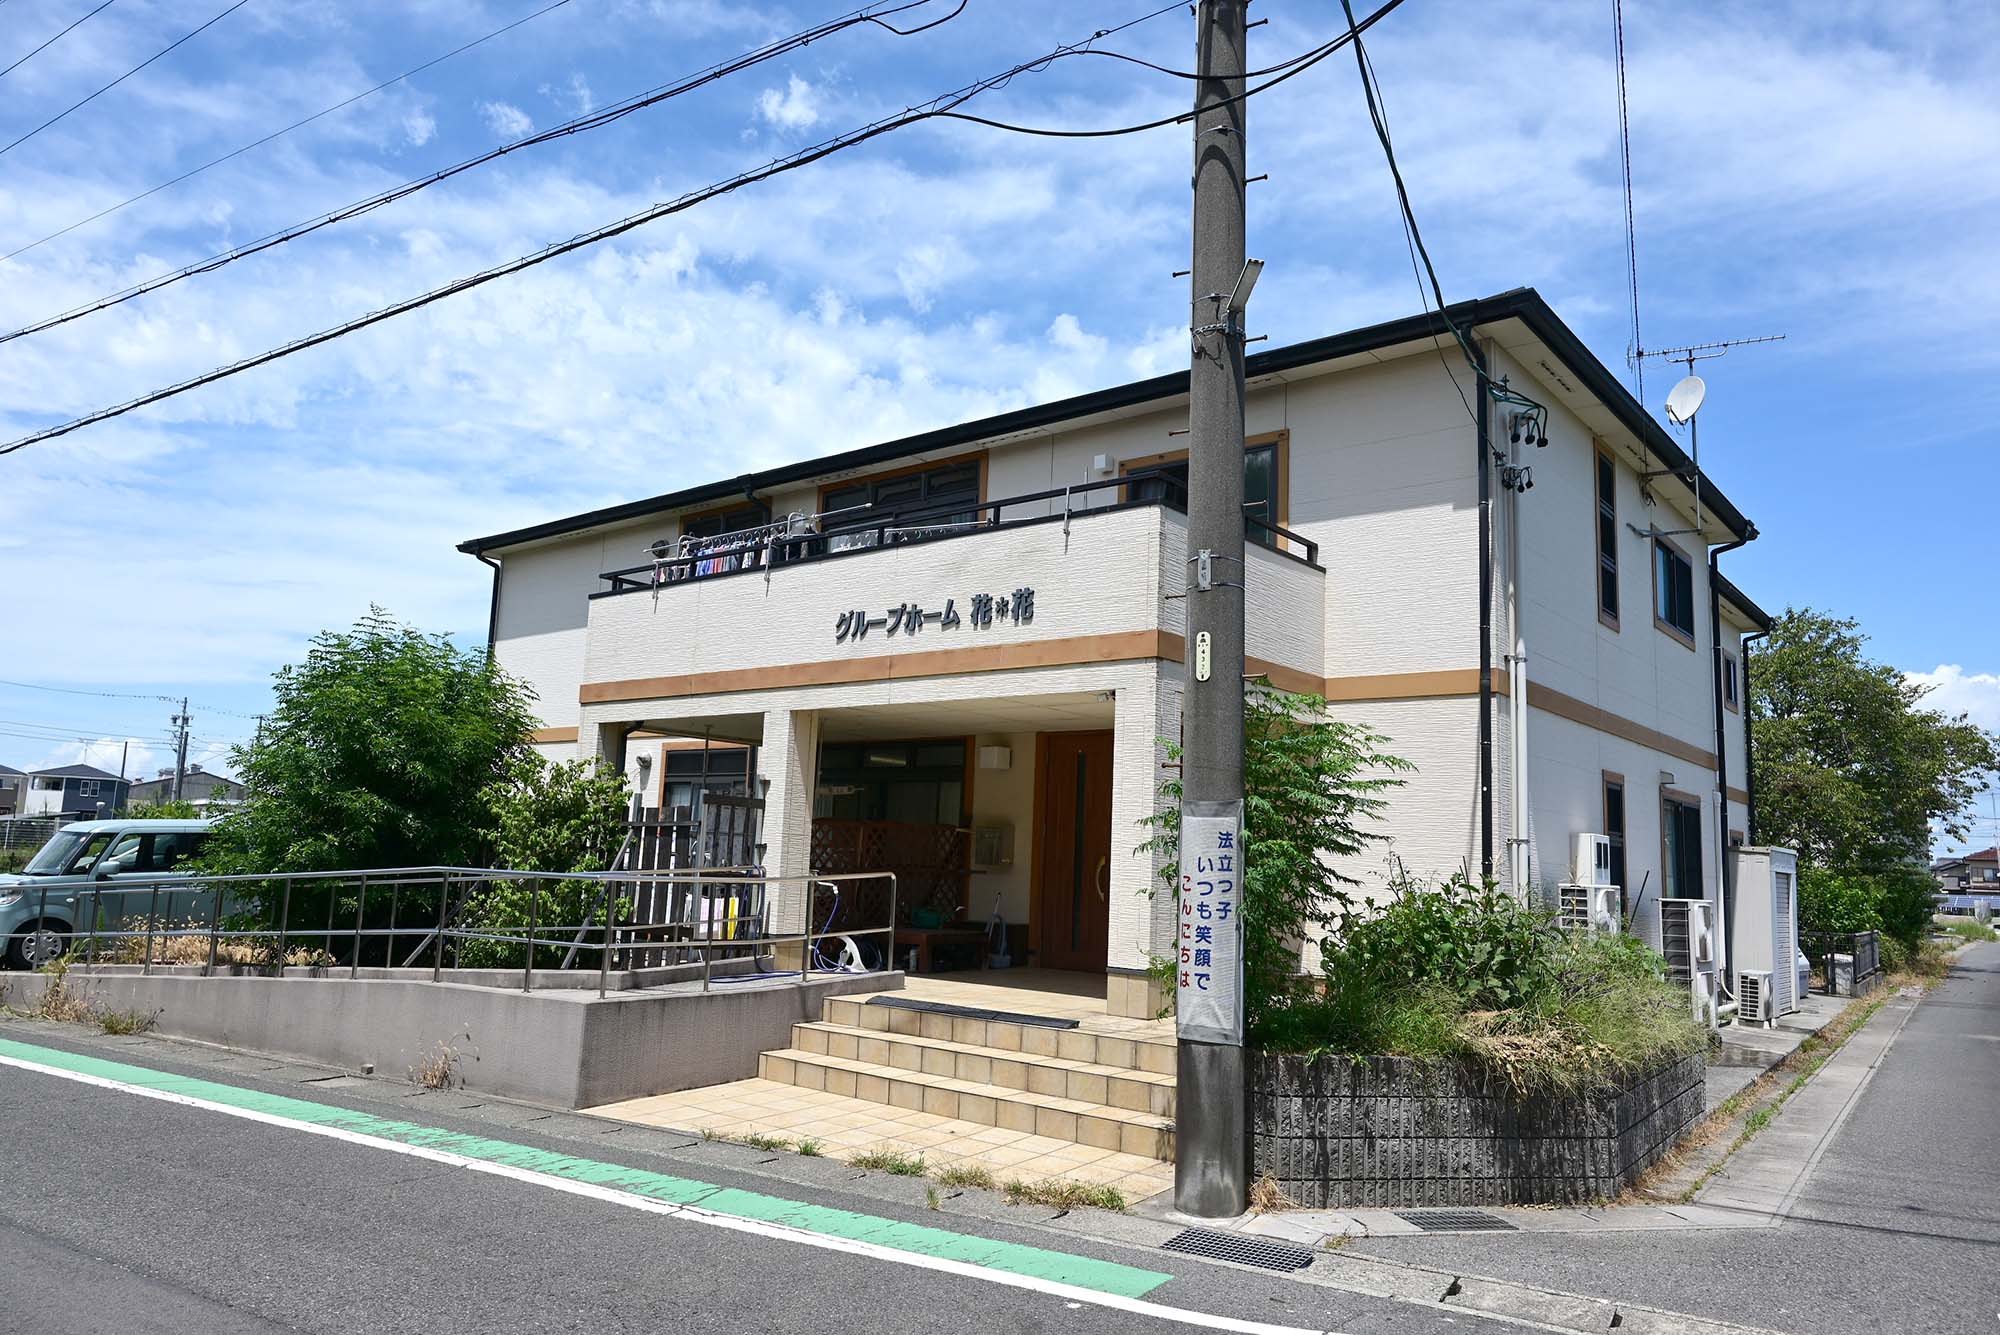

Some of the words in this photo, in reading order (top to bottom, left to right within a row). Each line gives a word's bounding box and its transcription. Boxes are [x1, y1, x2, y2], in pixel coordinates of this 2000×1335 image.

[836, 599, 960, 640] グループホーム
[1194, 856, 1213, 990] いつも笑顔で
[1216, 831, 1234, 920] 法立つ子
[1180, 875, 1192, 988] こんにちは
